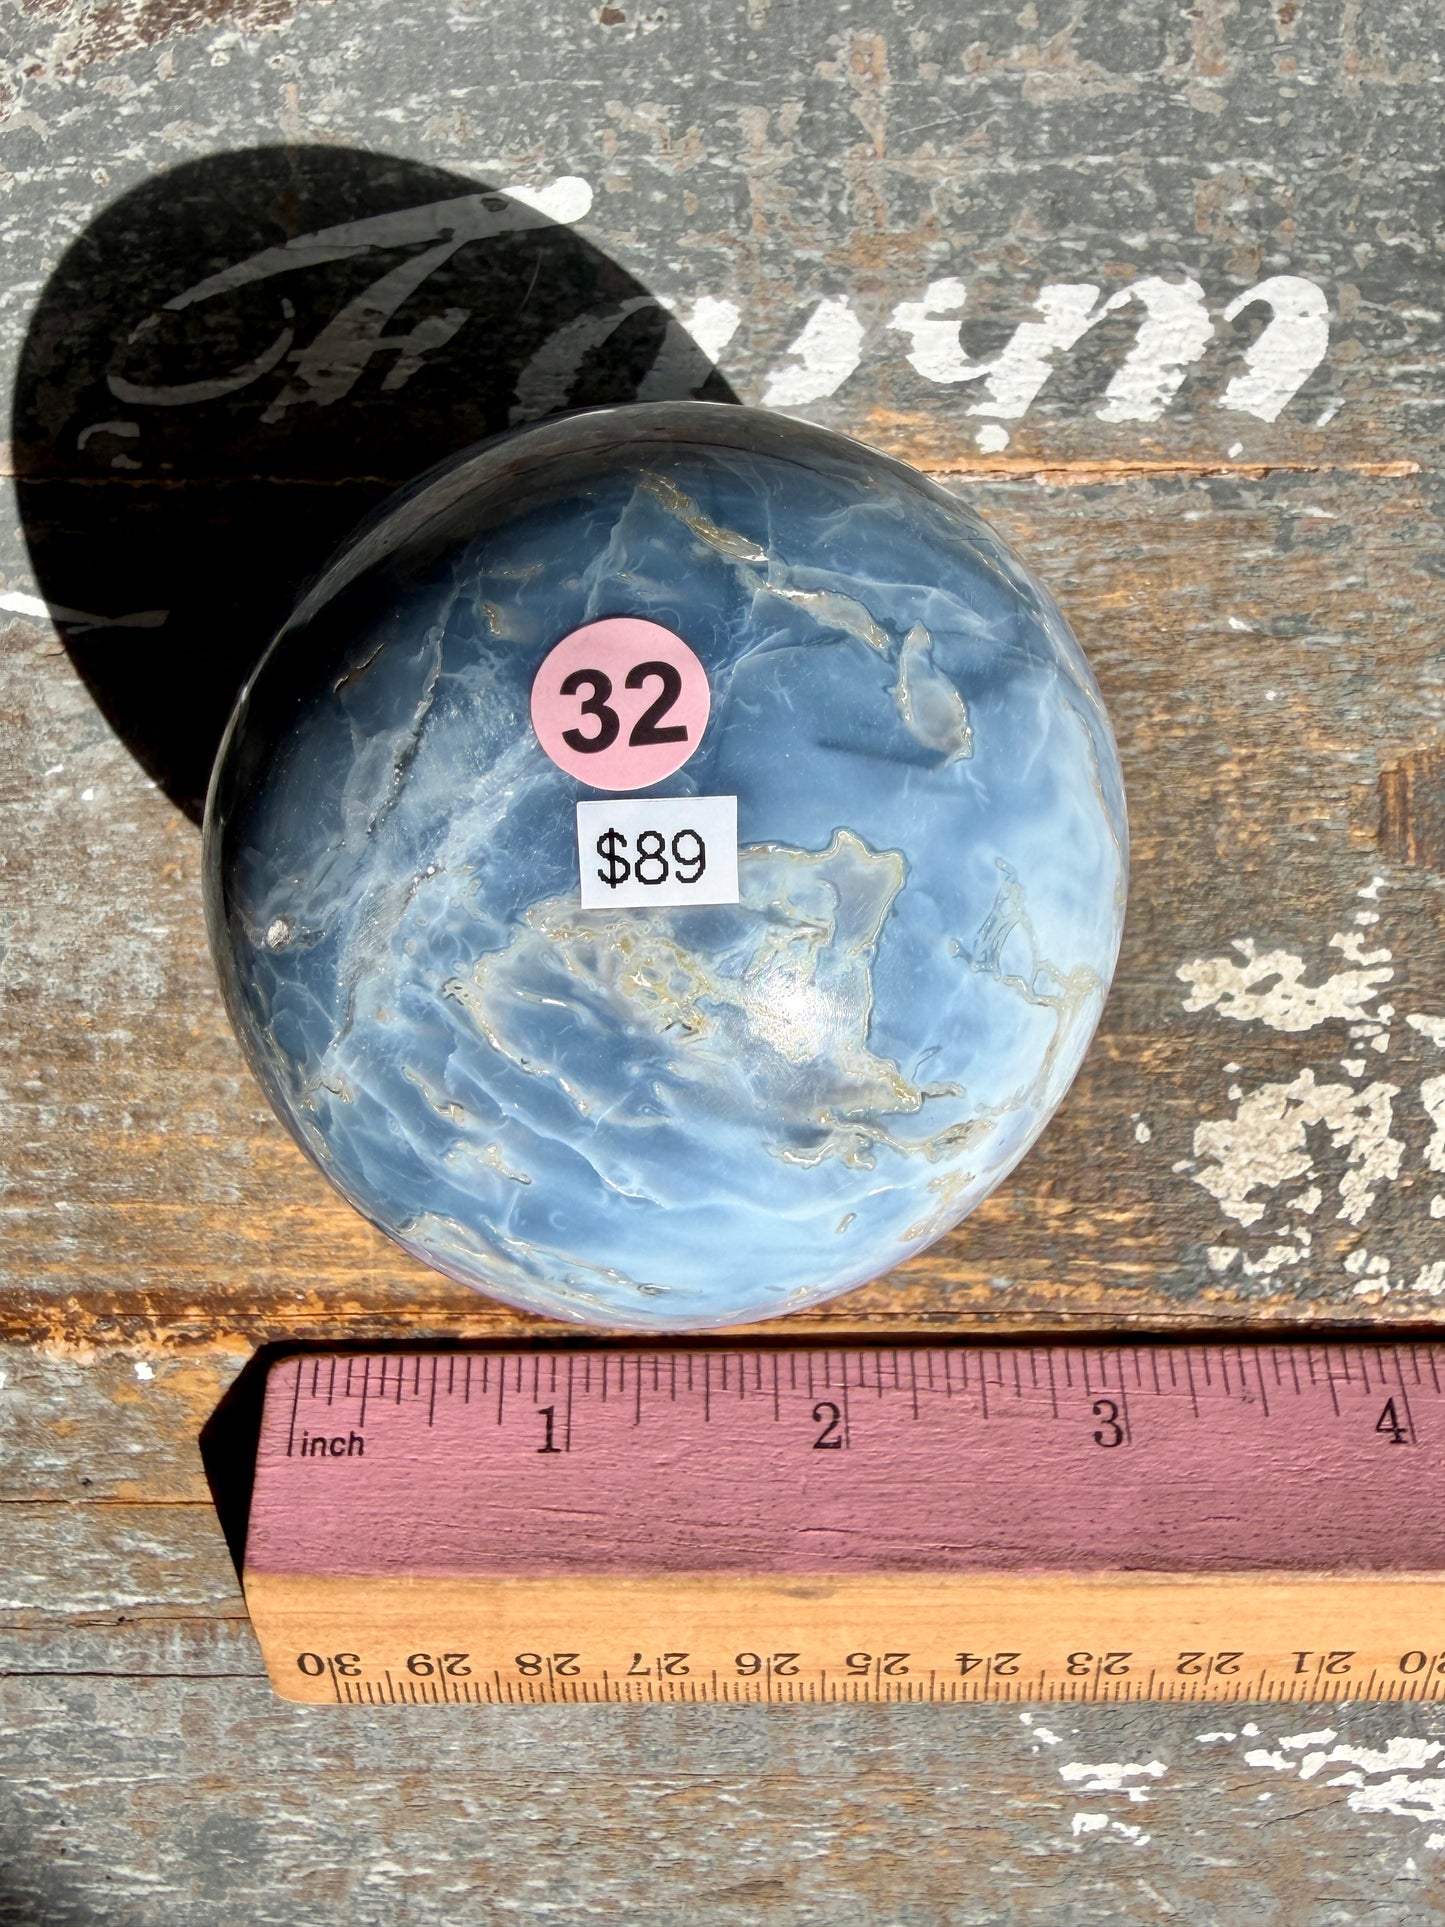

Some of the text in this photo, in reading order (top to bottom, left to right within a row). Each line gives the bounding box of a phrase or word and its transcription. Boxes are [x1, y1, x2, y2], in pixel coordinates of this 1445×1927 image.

[559, 660, 689, 755] 32
[596, 827, 706, 889] $89
[300, 1397, 1408, 1458] inch 1 2 3 4
[296, 1650, 1445, 1677] 0 21 22 23 24 25 26 27 28 29 30
